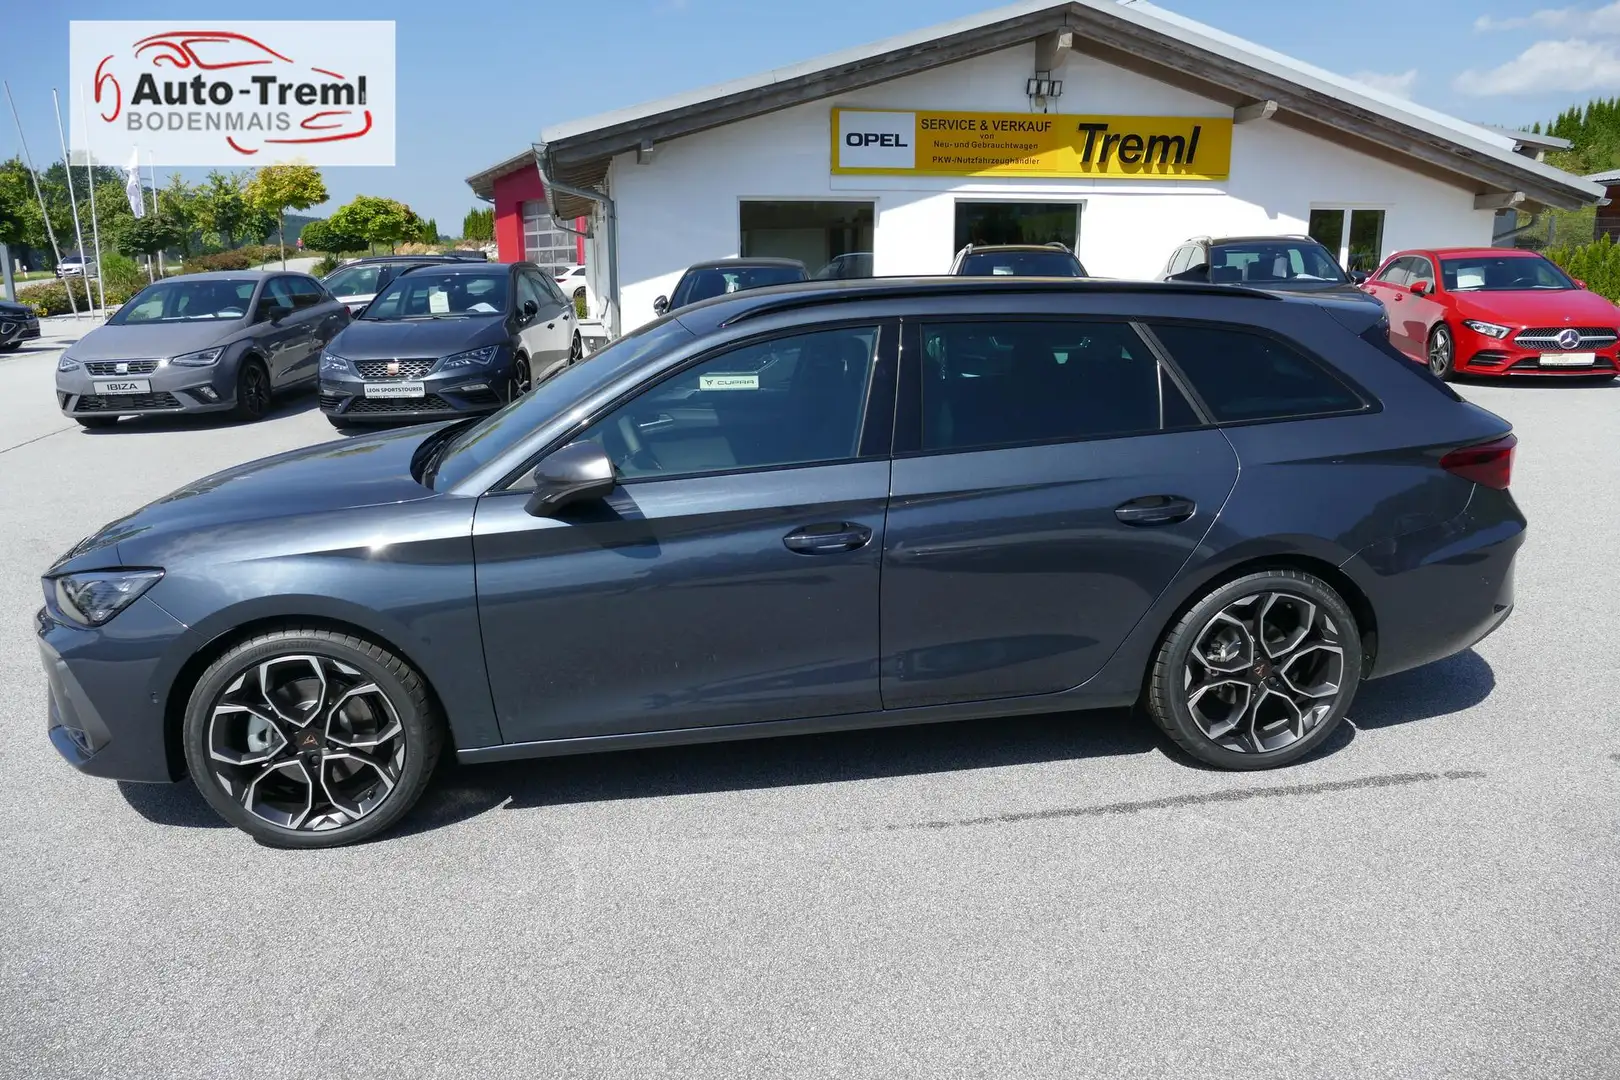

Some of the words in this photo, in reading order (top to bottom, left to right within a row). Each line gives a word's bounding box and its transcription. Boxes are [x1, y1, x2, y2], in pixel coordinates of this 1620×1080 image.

[921, 119, 976, 131] SERVICE
[980, 120, 988, 131] &
[992, 120, 1052, 133] VERKAUF
[845, 132, 908, 148] OPEL
[933, 140, 953, 149] Neu-
[954, 141, 970, 149] und
[971, 141, 1039, 151] Gebrauchtwagen
[1078, 123, 1202, 164] Treml
